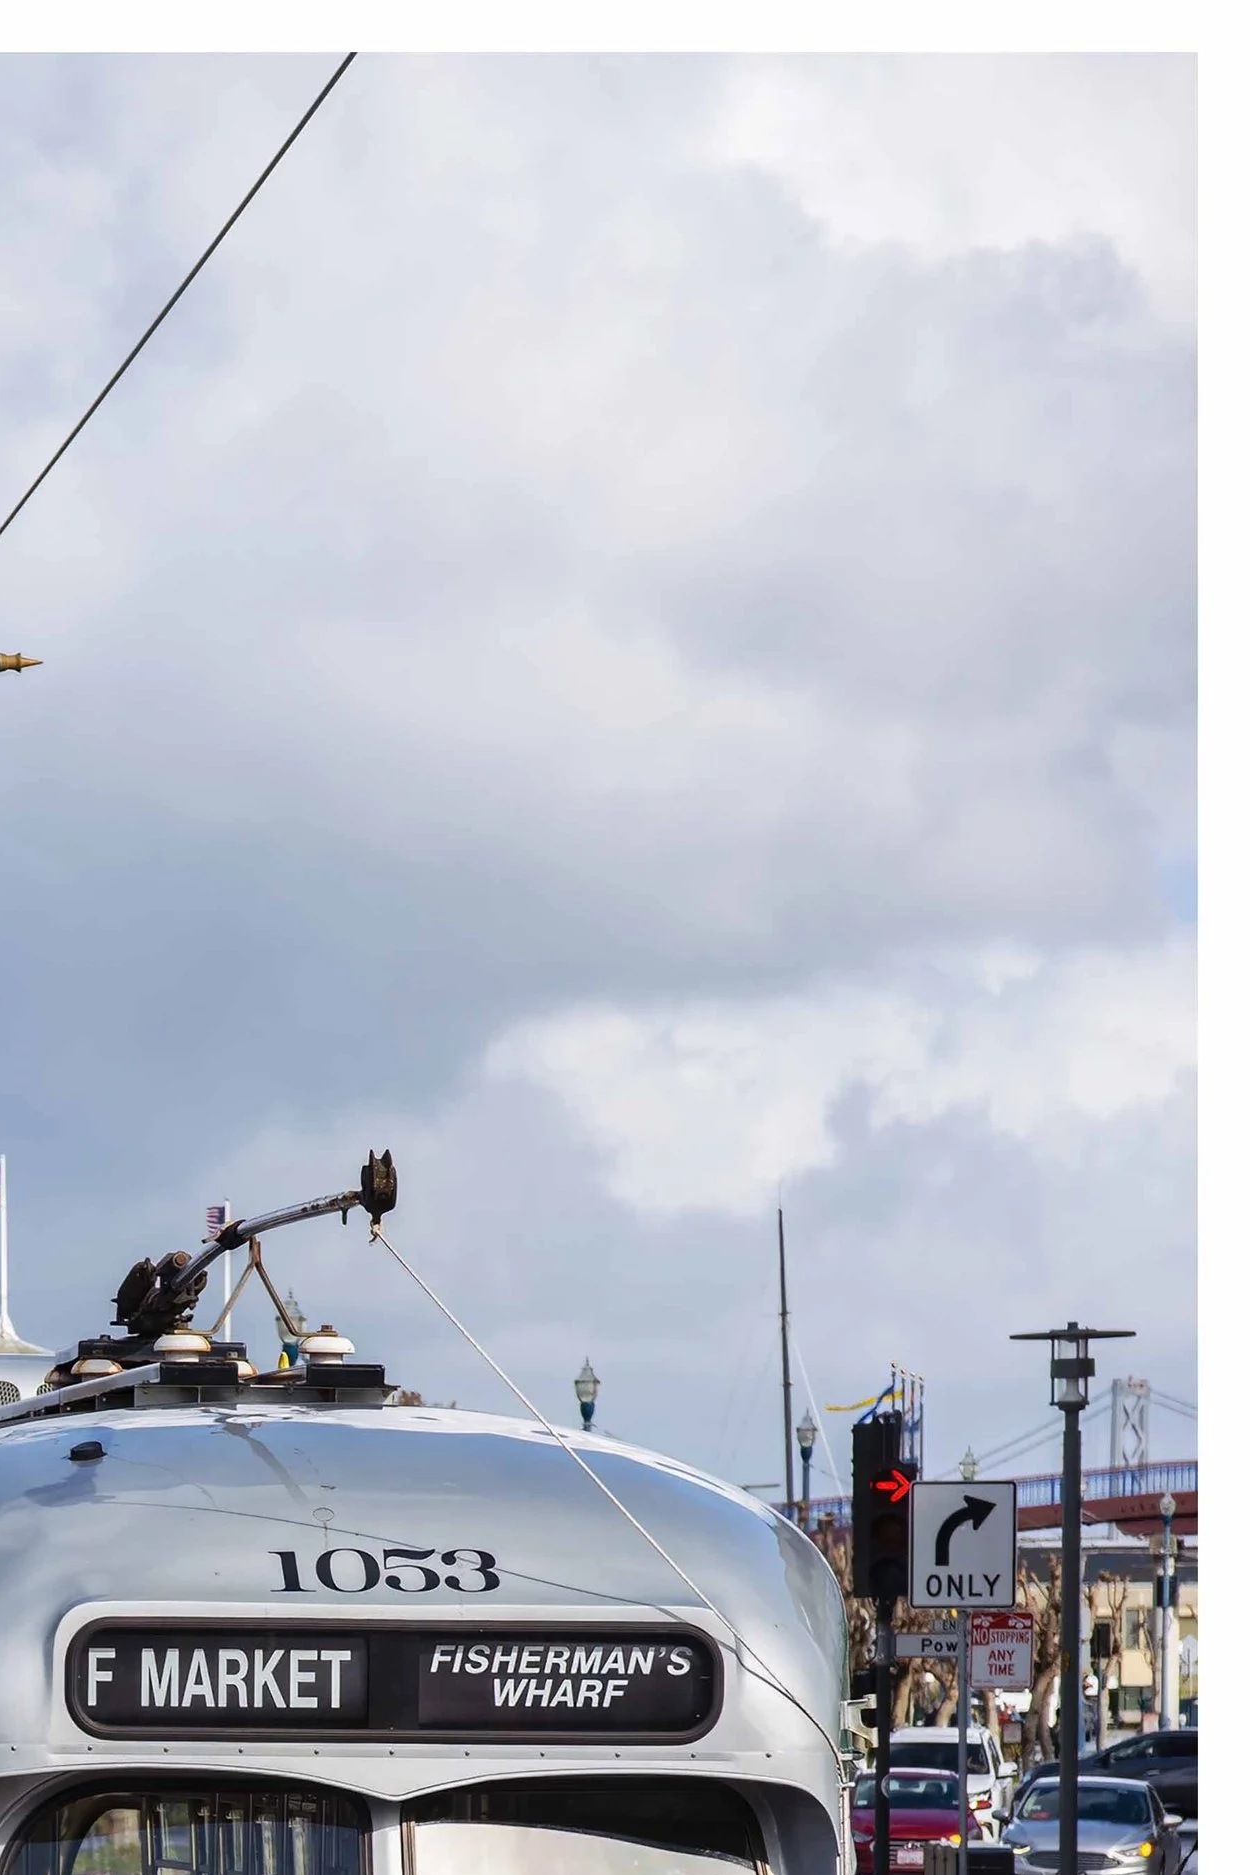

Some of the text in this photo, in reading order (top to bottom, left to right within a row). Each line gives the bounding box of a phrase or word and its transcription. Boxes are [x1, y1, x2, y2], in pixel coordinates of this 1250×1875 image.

[268, 1548, 500, 1593] 1053
[926, 1574, 1001, 1598] ONLY
[921, 1638, 959, 1653] Pow
[972, 1628, 1029, 1645] NO STOPPING
[429, 1645, 693, 1677] FISHERMAN'S
[988, 1650, 1015, 1662] ANY
[87, 1647, 352, 1709] F MARKET
[988, 1663, 1015, 1677] TIME
[492, 1679, 629, 1708] WHARF
